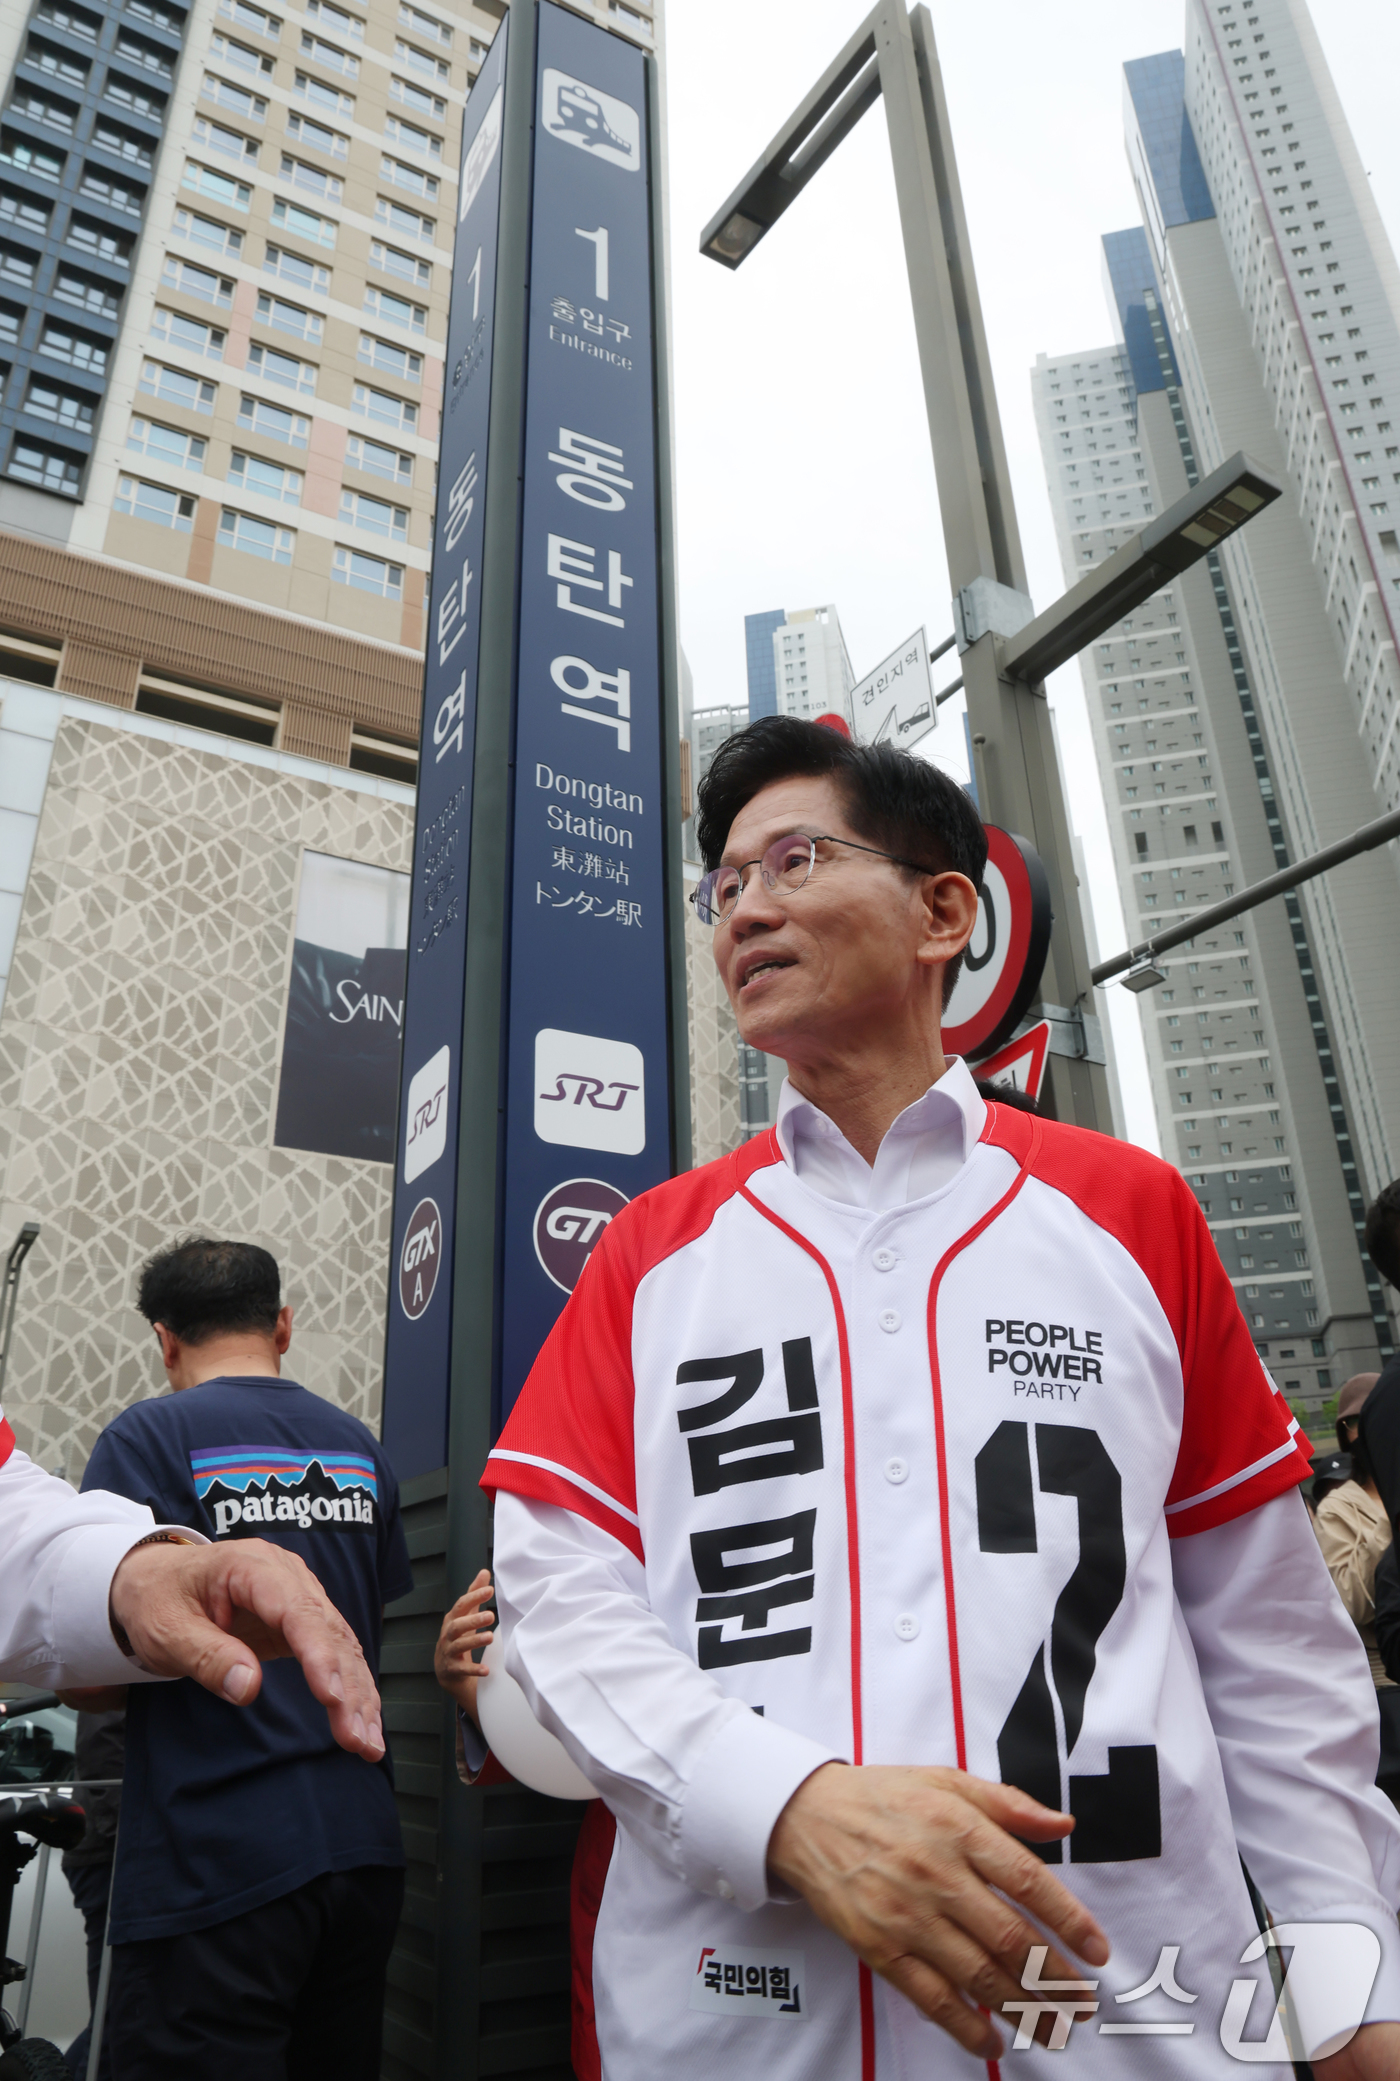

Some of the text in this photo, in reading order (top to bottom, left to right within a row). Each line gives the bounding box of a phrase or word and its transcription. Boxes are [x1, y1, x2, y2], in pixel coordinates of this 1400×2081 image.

[468, 246, 482, 321] 1
[575, 226, 608, 301] 1
[550, 296, 632, 343] 출입구
[549, 324, 632, 371] Entrance
[433, 451, 478, 764] 동탄역
[547, 426, 634, 753] 동탄역
[862, 647, 918, 706] 견인지역
[536, 763, 643, 815] Dongtan
[547, 804, 633, 849] Station
[552, 846, 629, 886] 東灘站
[536, 880, 643, 928] トンタン駅
[408, 1084, 446, 1146] SRT
[539, 1073, 640, 1111] SRT
[404, 1220, 437, 1272] GTX
[412, 1272, 423, 1306] A
[986, 1319, 1103, 1356] PEOPLE
[988, 1348, 1103, 1384] POWER
[1014, 1380, 1081, 1401] PARTY
[213, 1491, 373, 1534] patagonia
[676, 1336, 824, 1717] 김문
[975, 1420, 1161, 1863] 2
[704, 1961, 791, 2000] 국민의힘
